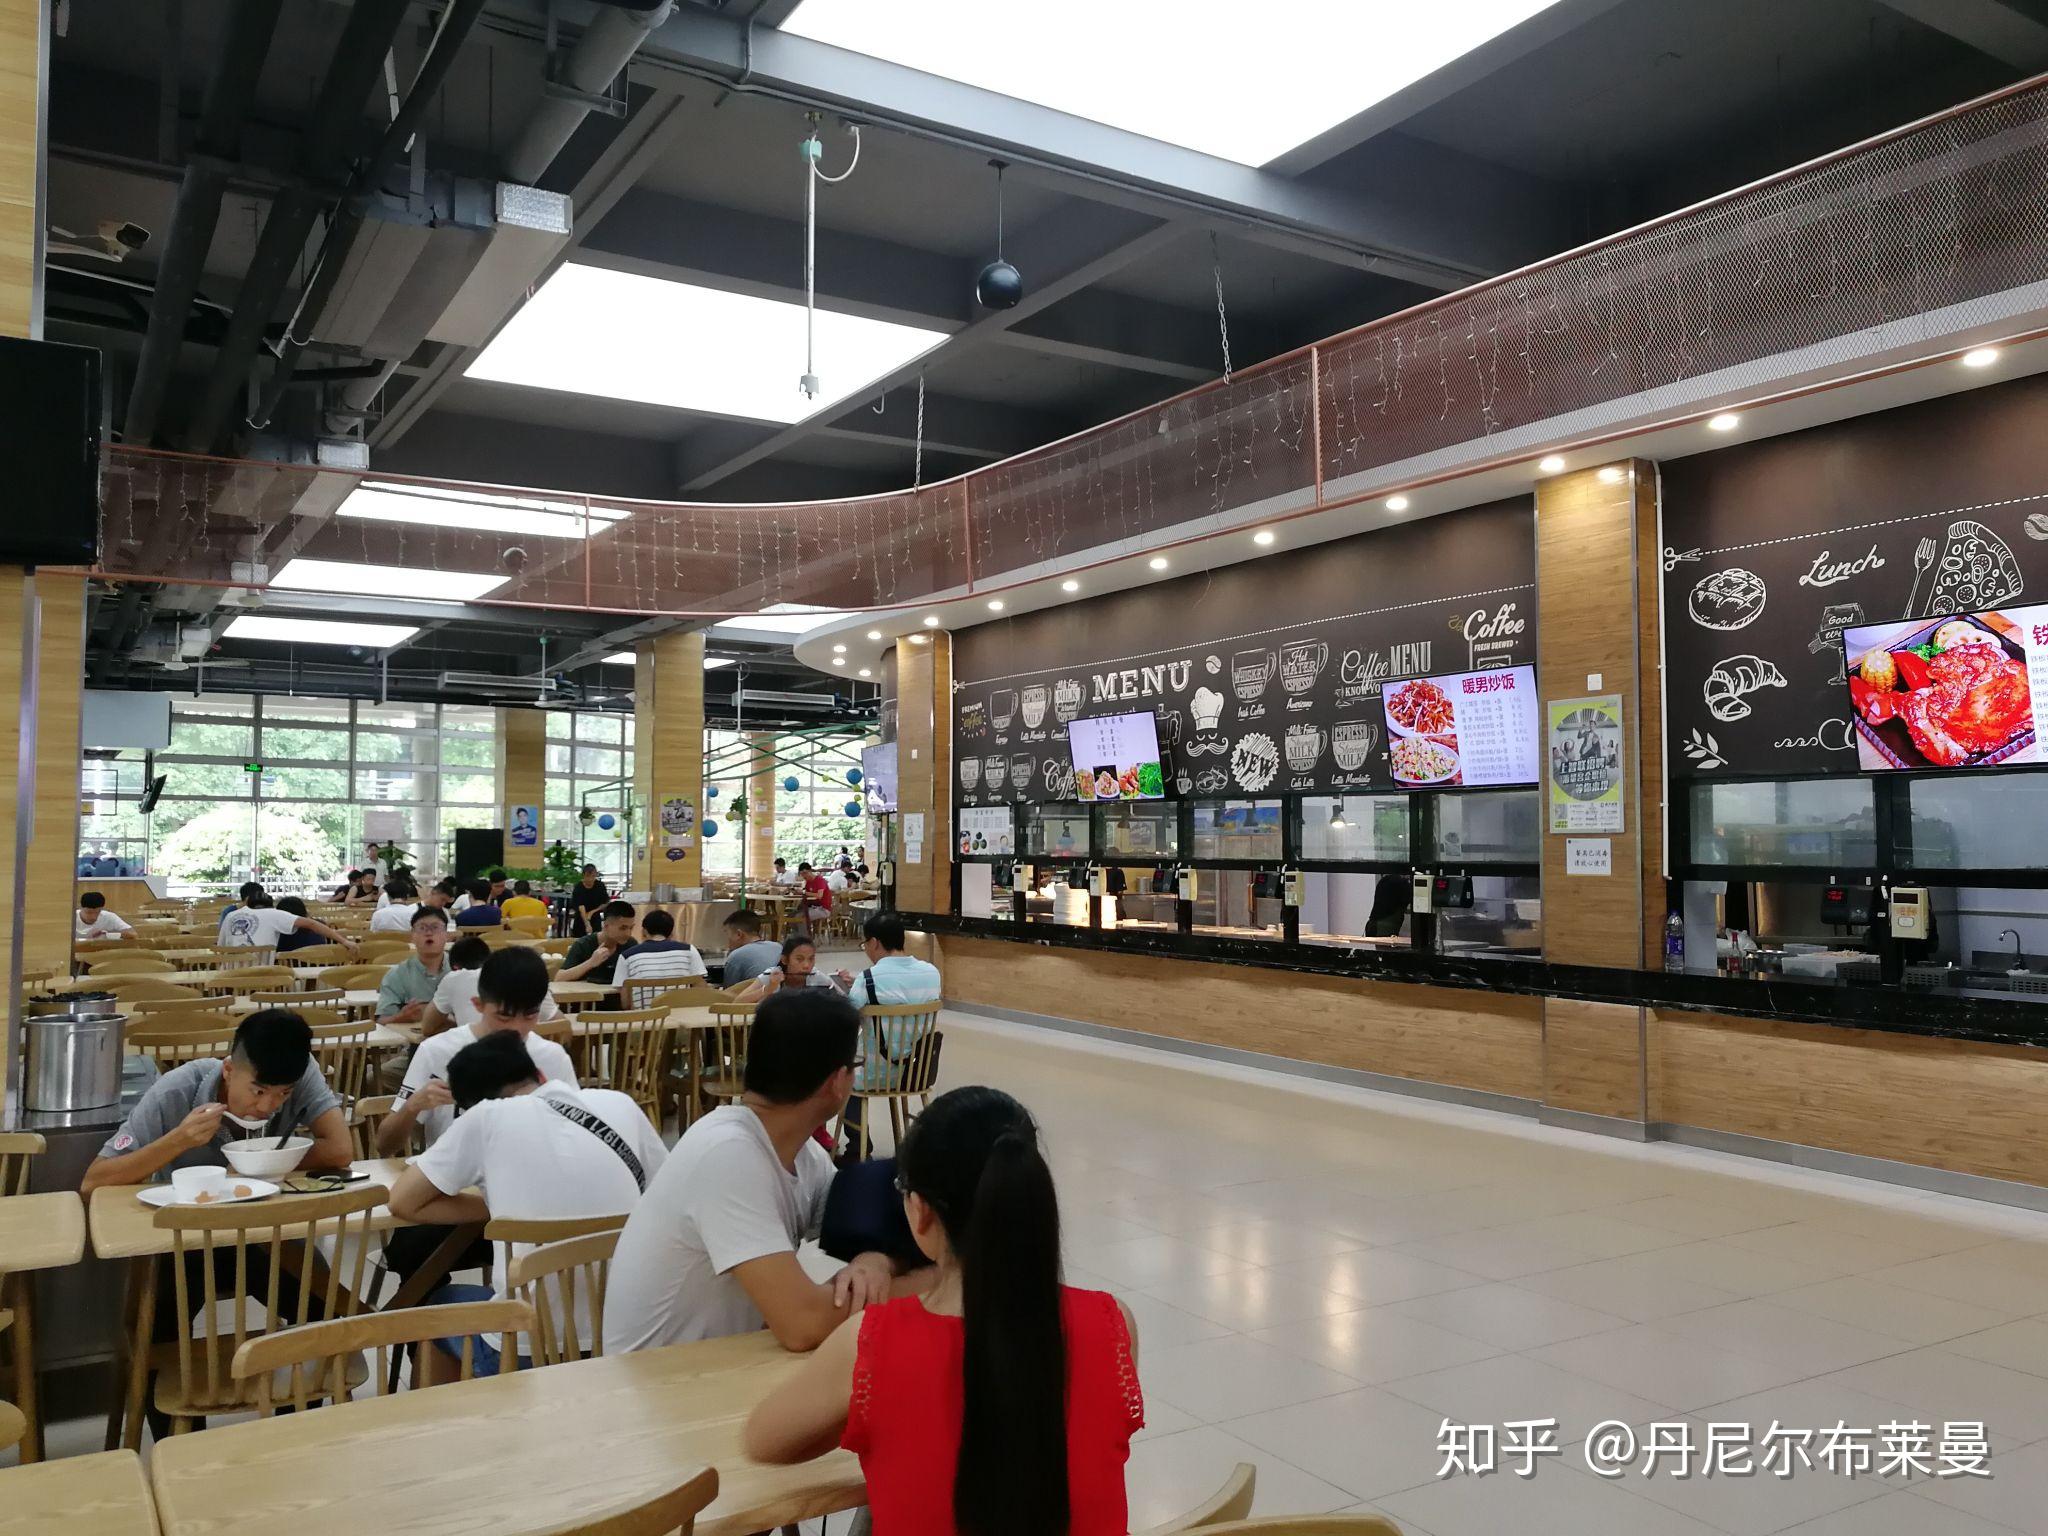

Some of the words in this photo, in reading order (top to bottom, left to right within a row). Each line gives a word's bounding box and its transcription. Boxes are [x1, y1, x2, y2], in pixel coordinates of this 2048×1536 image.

[1799, 545, 1885, 587] Lunch
[1463, 603, 1525, 641] Coffee
[1828, 612, 1854, 625] Good
[1474, 643, 1490, 652] FRESH
[1491, 640, 1514, 650] BREWED
[1282, 661, 1317, 676] WATER
[1341, 650, 1389, 690] Coffee
[1390, 641, 1432, 676] MENU
[1092, 659, 1193, 704] MENU
[1234, 667, 1268, 683] WHISKEY
[1344, 684, 1368, 697] KNOW
[1462, 673, 1515, 694] 暖男炒饭
[961, 701, 983, 714] PREMIUM
[1250, 704, 1266, 716] Coffee
[1335, 724, 1368, 741] ESPRESSO
[1289, 745, 1315, 758] MILK
[1337, 753, 1364, 766] MILK
[589, 1119, 621, 1148] 1971
